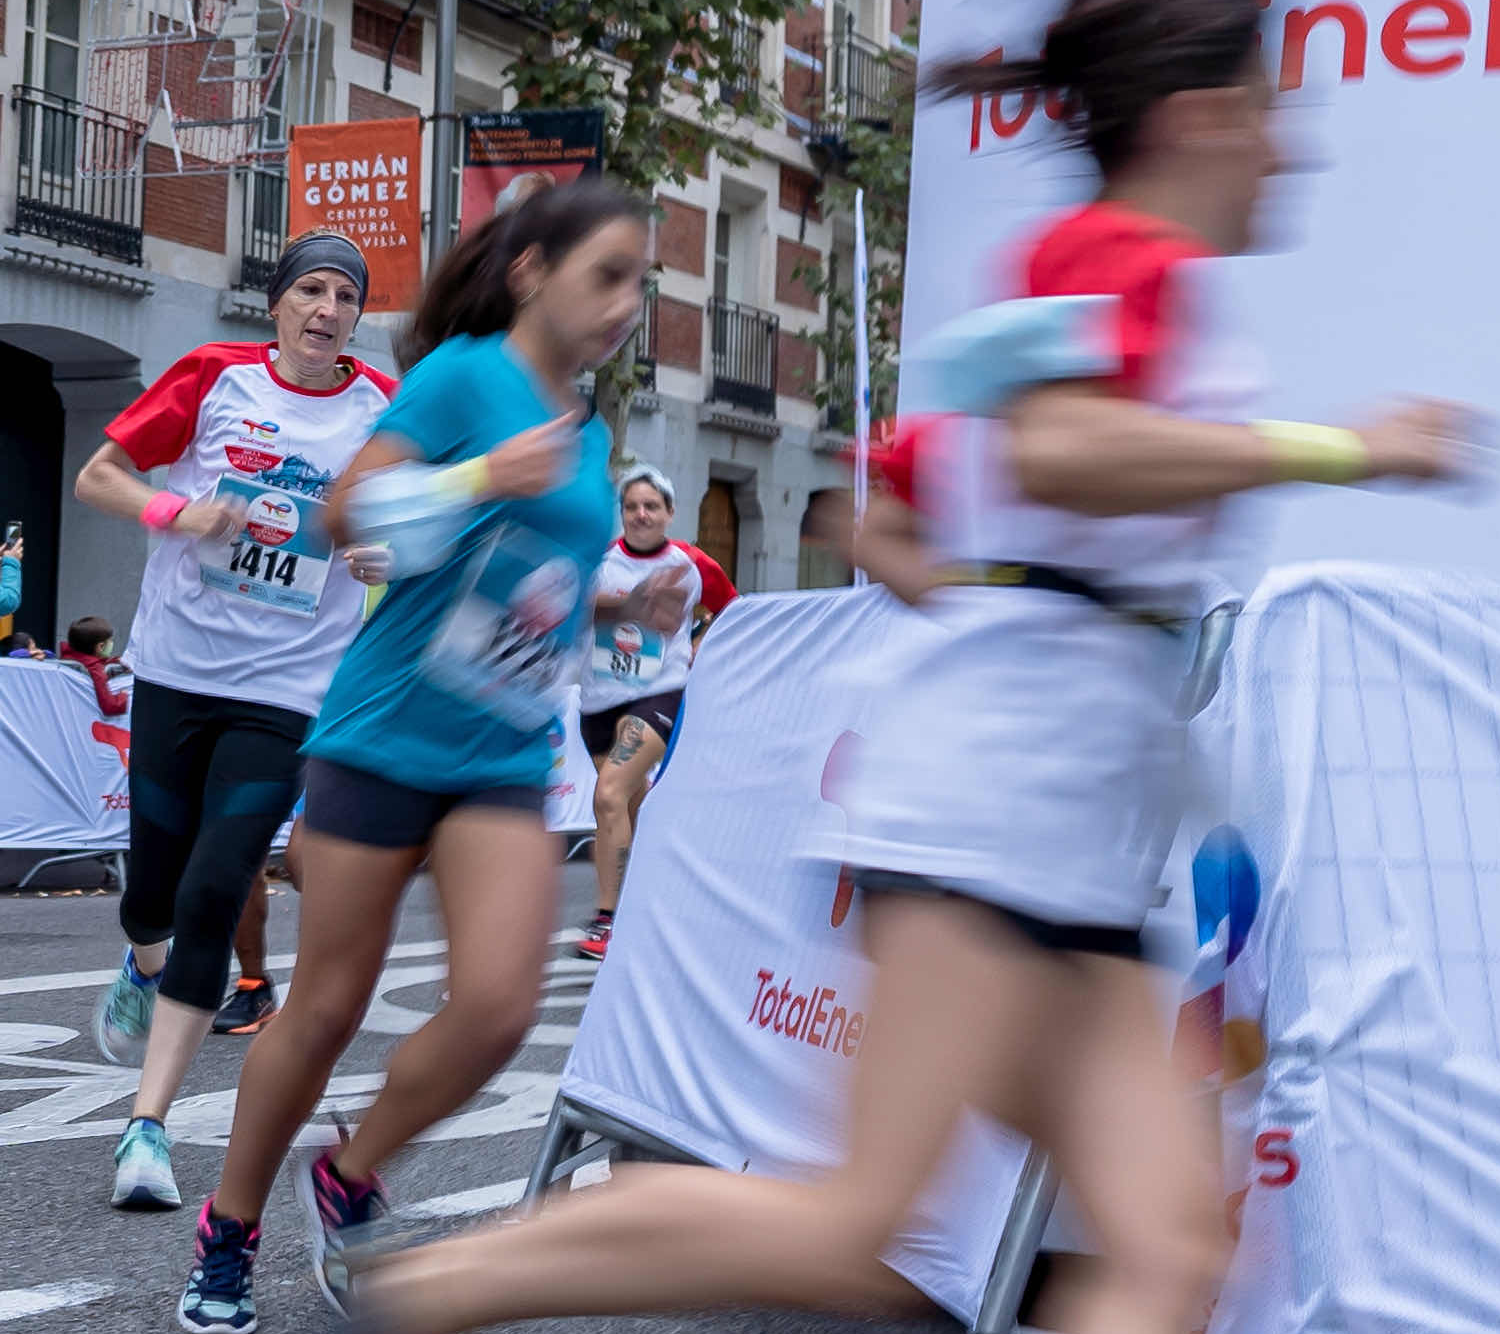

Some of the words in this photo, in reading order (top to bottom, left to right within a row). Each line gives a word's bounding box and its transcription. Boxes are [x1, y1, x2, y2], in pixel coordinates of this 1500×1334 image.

[305, 153, 408, 182] FERNÁN
[305, 180, 408, 205] GÓMEZ
[326, 207, 390, 221] CENTRO
[363, 234, 408, 247] VILLA
[230, 541, 298, 587] 1414
[748, 968, 870, 1058] TotalEne
